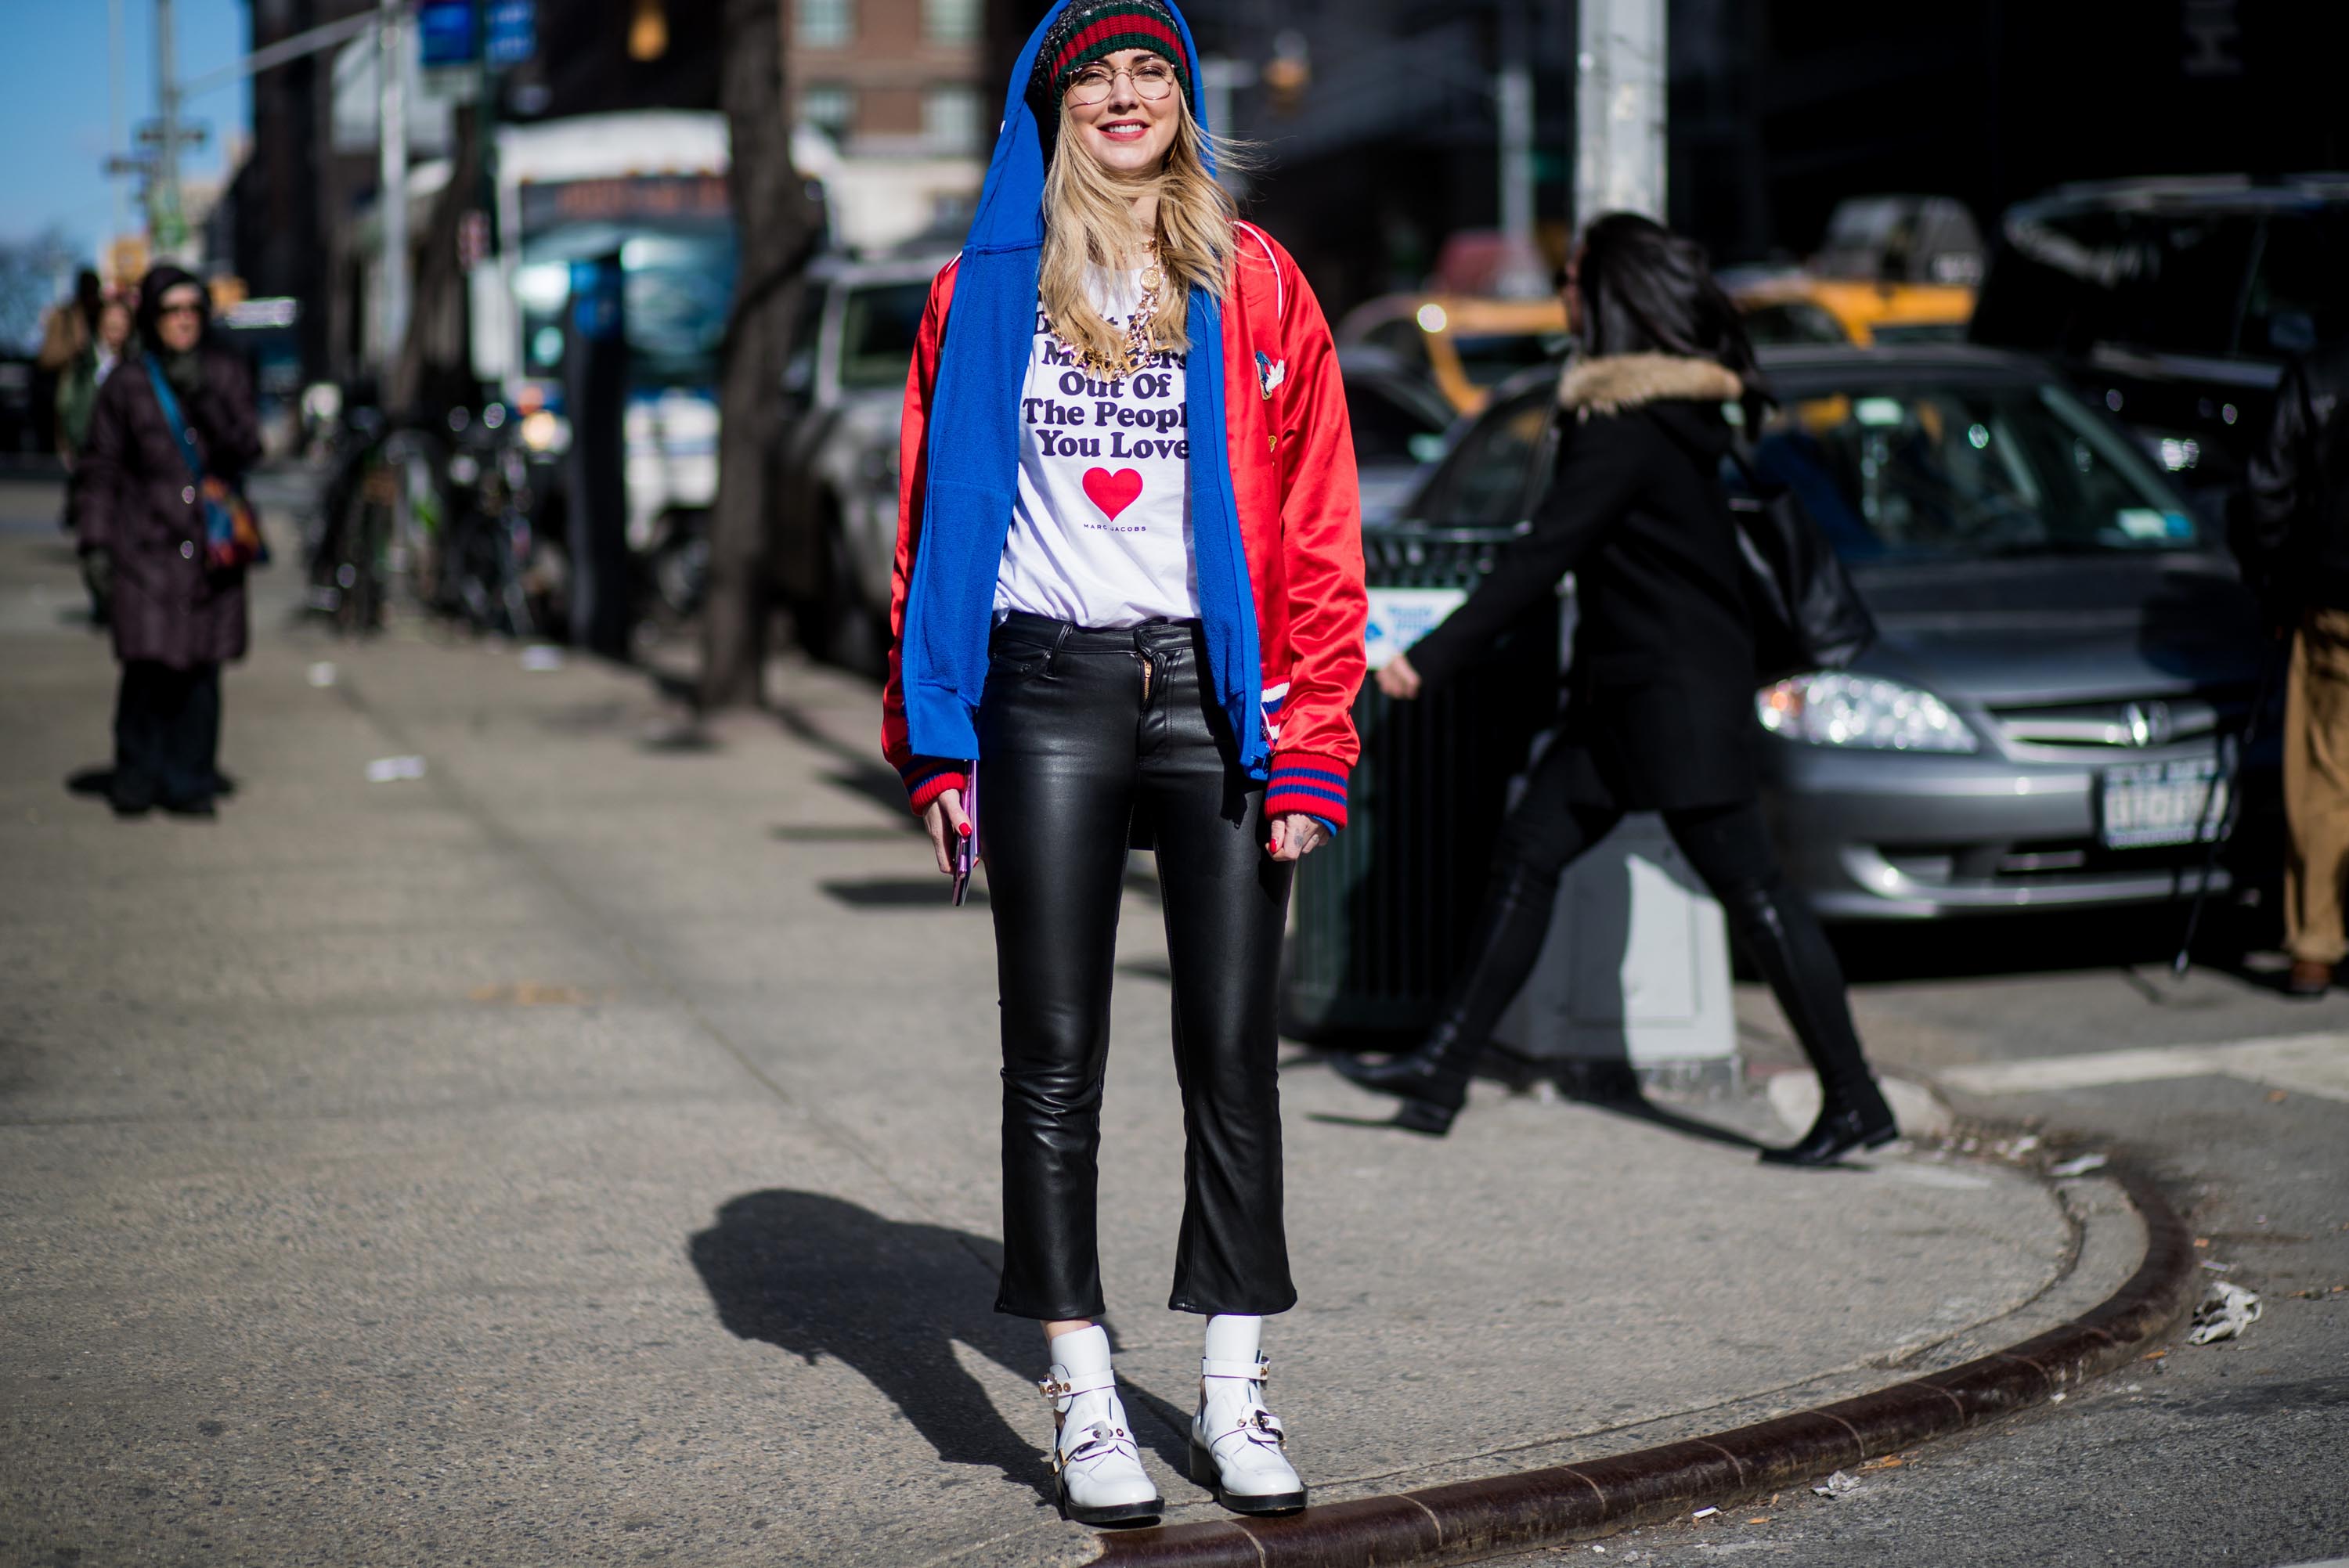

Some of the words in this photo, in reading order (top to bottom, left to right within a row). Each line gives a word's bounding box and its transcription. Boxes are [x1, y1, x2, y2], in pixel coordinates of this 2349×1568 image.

[1059, 371, 1124, 398] Out
[1133, 373, 1172, 399] Of
[1023, 398, 1085, 426] The
[1095, 402, 1188, 434] Peopl
[1035, 429, 1101, 457] You
[1110, 432, 1189, 460] Love
